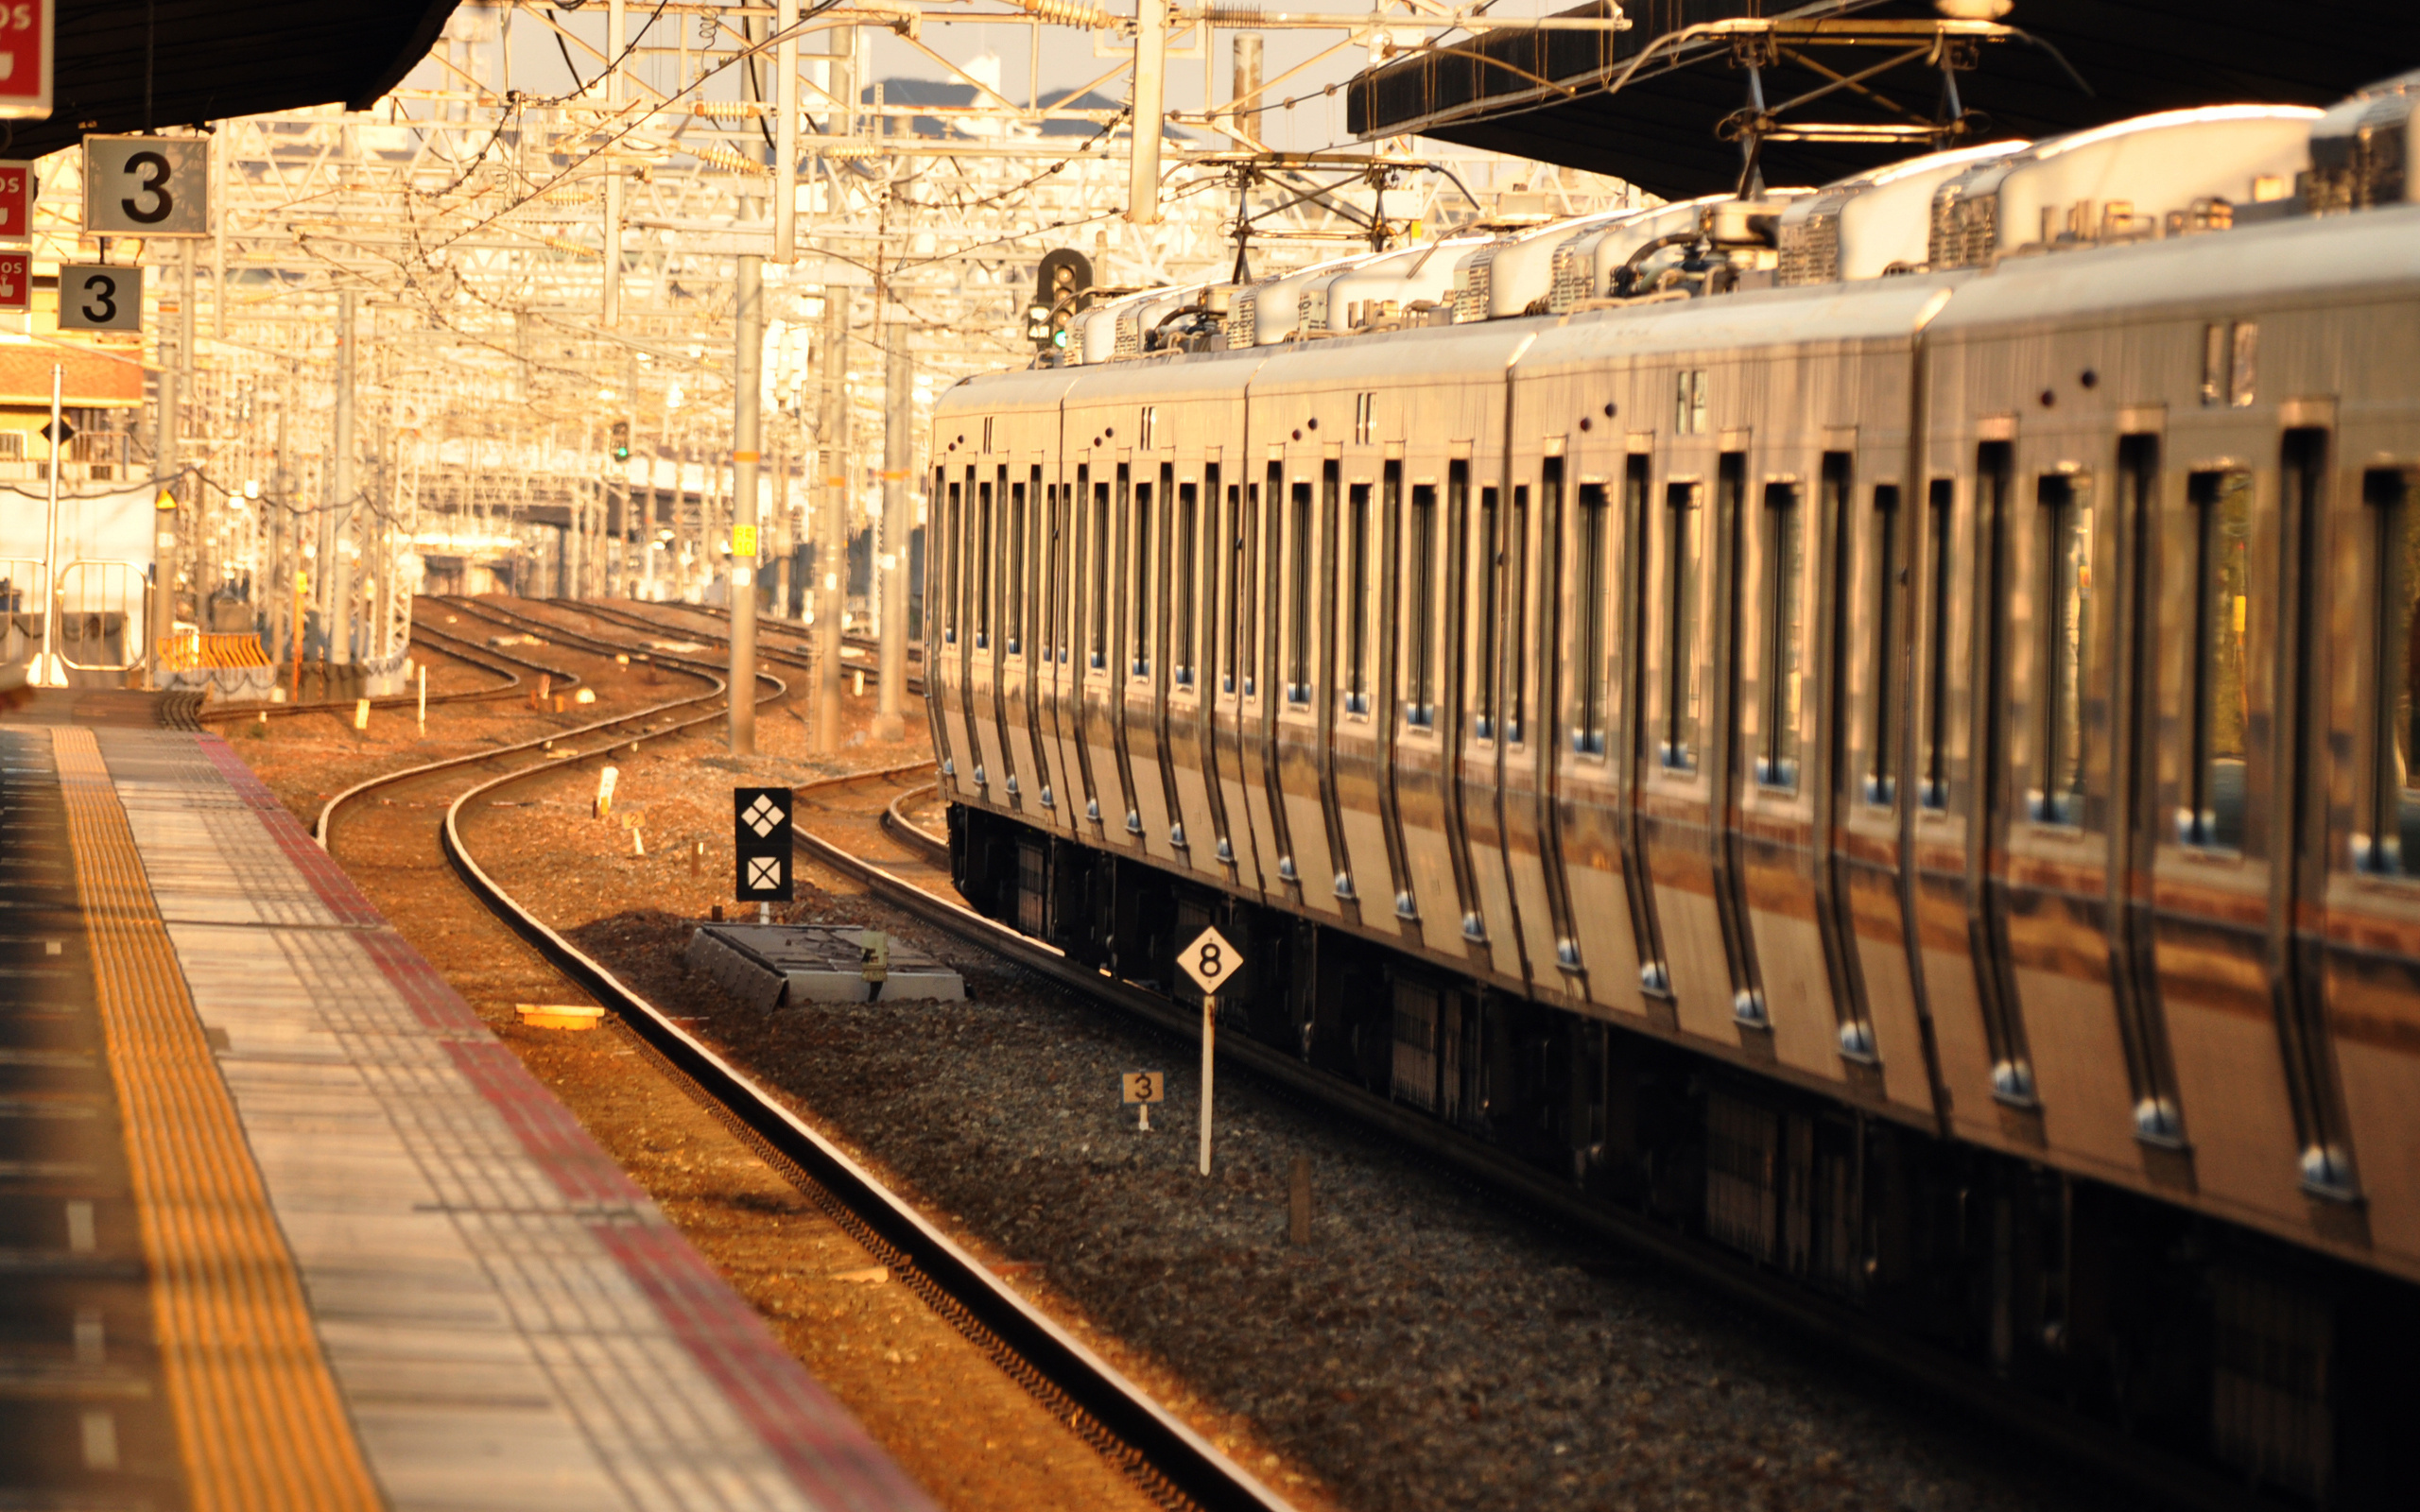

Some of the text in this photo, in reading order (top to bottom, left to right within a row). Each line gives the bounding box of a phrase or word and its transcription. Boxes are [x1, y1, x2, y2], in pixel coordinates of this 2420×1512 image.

[121, 151, 173, 224] 3
[82, 274, 116, 323] 3
[630, 813, 639, 827] 2
[1199, 942, 1222, 978] 8
[1134, 1075, 1153, 1100] 3
